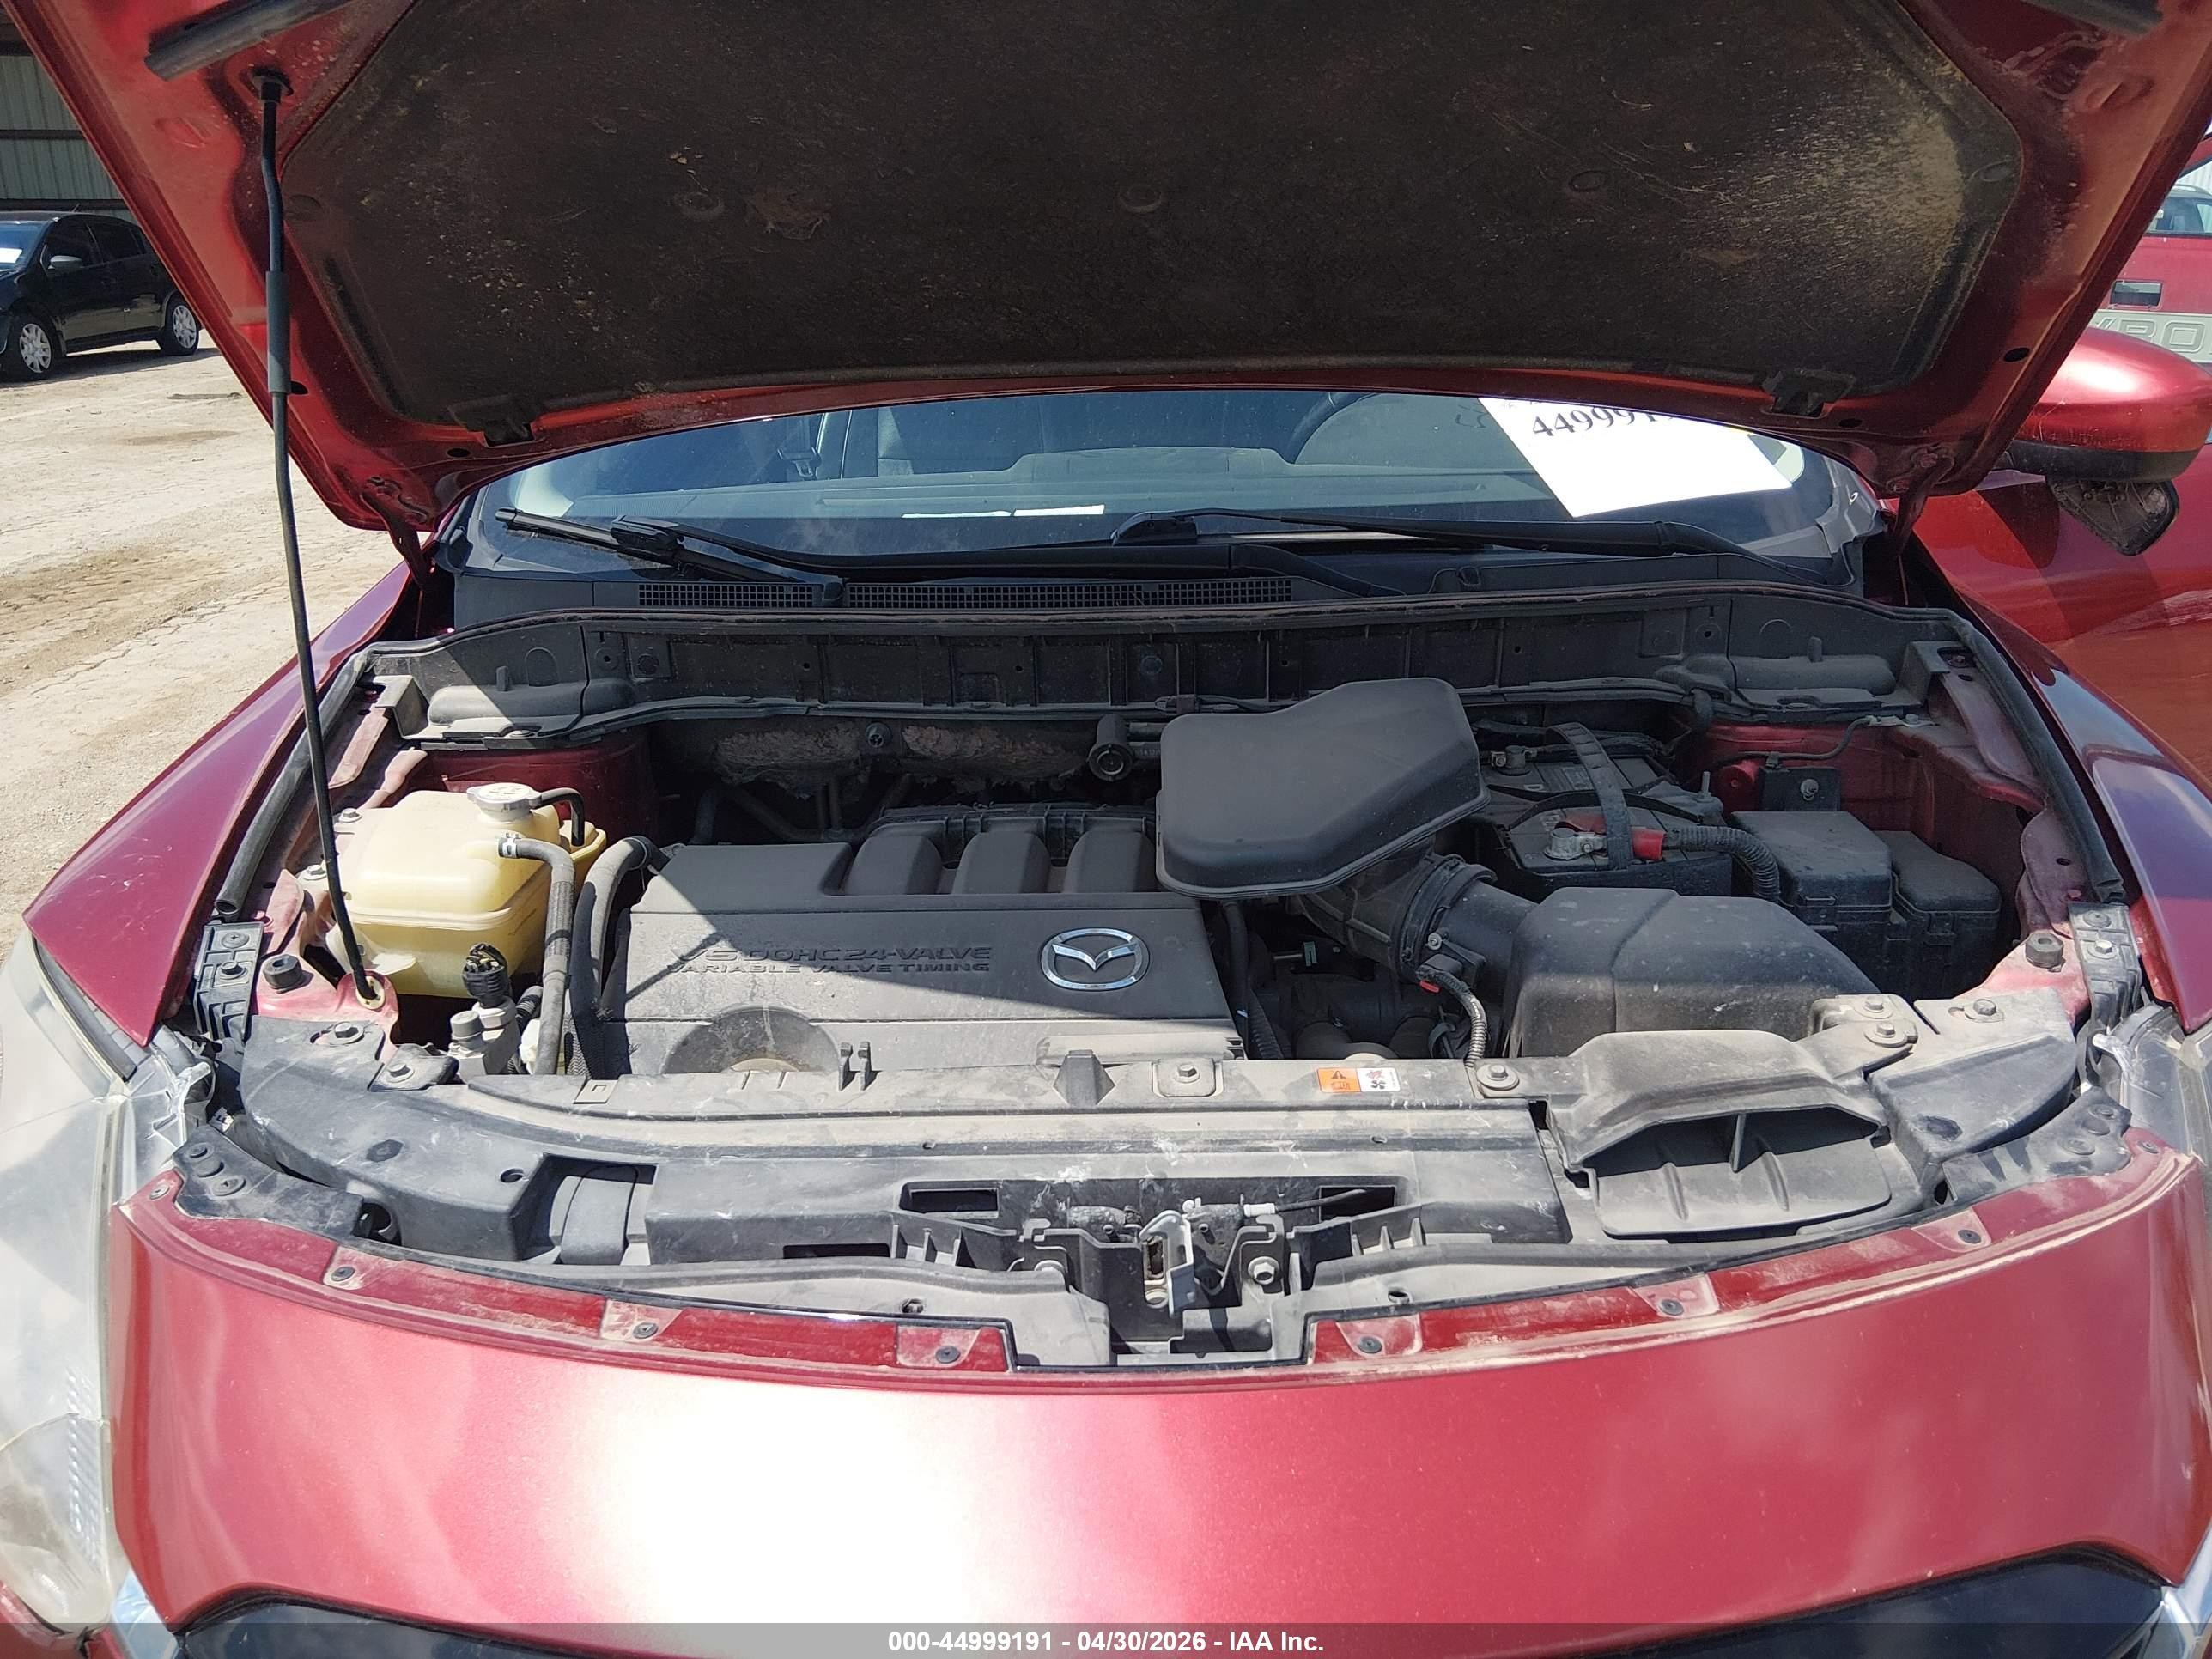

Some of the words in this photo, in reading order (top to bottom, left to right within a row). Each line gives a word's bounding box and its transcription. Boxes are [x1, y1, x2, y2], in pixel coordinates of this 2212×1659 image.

[744, 949, 840, 962] DOHC
[844, 947, 993, 961] 24-VALVE
[667, 963, 802, 974] VARIABLE
[811, 963, 893, 974] VALVE
[895, 963, 990, 973] TIMING
